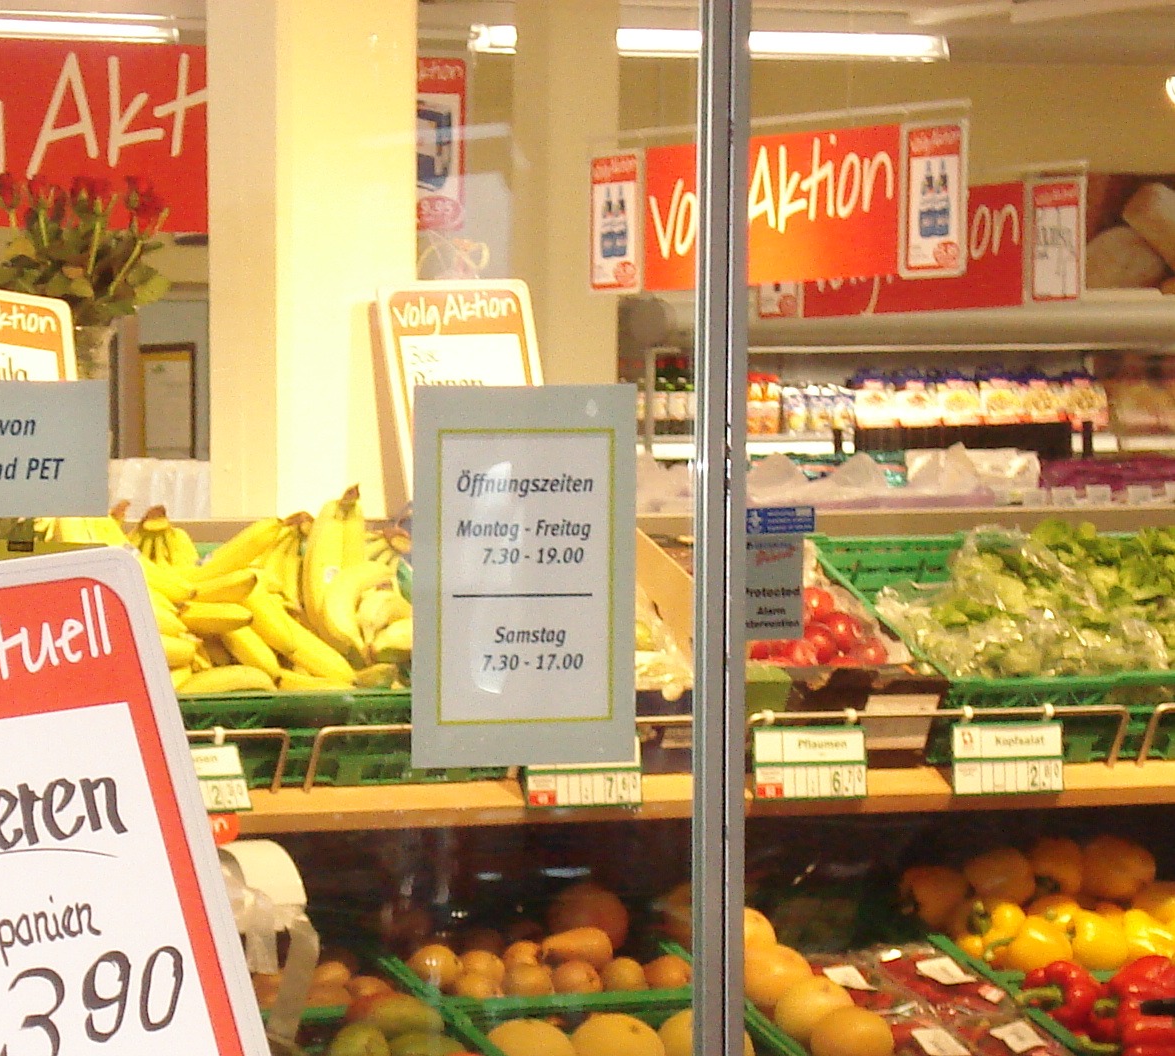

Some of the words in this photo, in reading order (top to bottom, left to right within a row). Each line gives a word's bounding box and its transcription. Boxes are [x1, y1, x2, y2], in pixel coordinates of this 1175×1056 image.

[747, 133, 894, 234] Aktion
[392, 295, 442, 336] Volg
[443, 290, 518, 326] Aktion
[26, 457, 65, 481] PET
[456, 469, 594, 499] Öffnungszeiten
[456, 519, 520, 541] Montag
[535, 518, 592, 541] Freitag
[482, 547, 520, 566] 7.30
[536, 546, 585, 565] 19.00
[494, 626, 567, 648] Samstag
[482, 654, 520, 672] 7.30
[535, 652, 584, 671] 17.00
[797, 737, 848, 751] Pflaumen
[994, 734, 1046, 748] Kopfsalat
